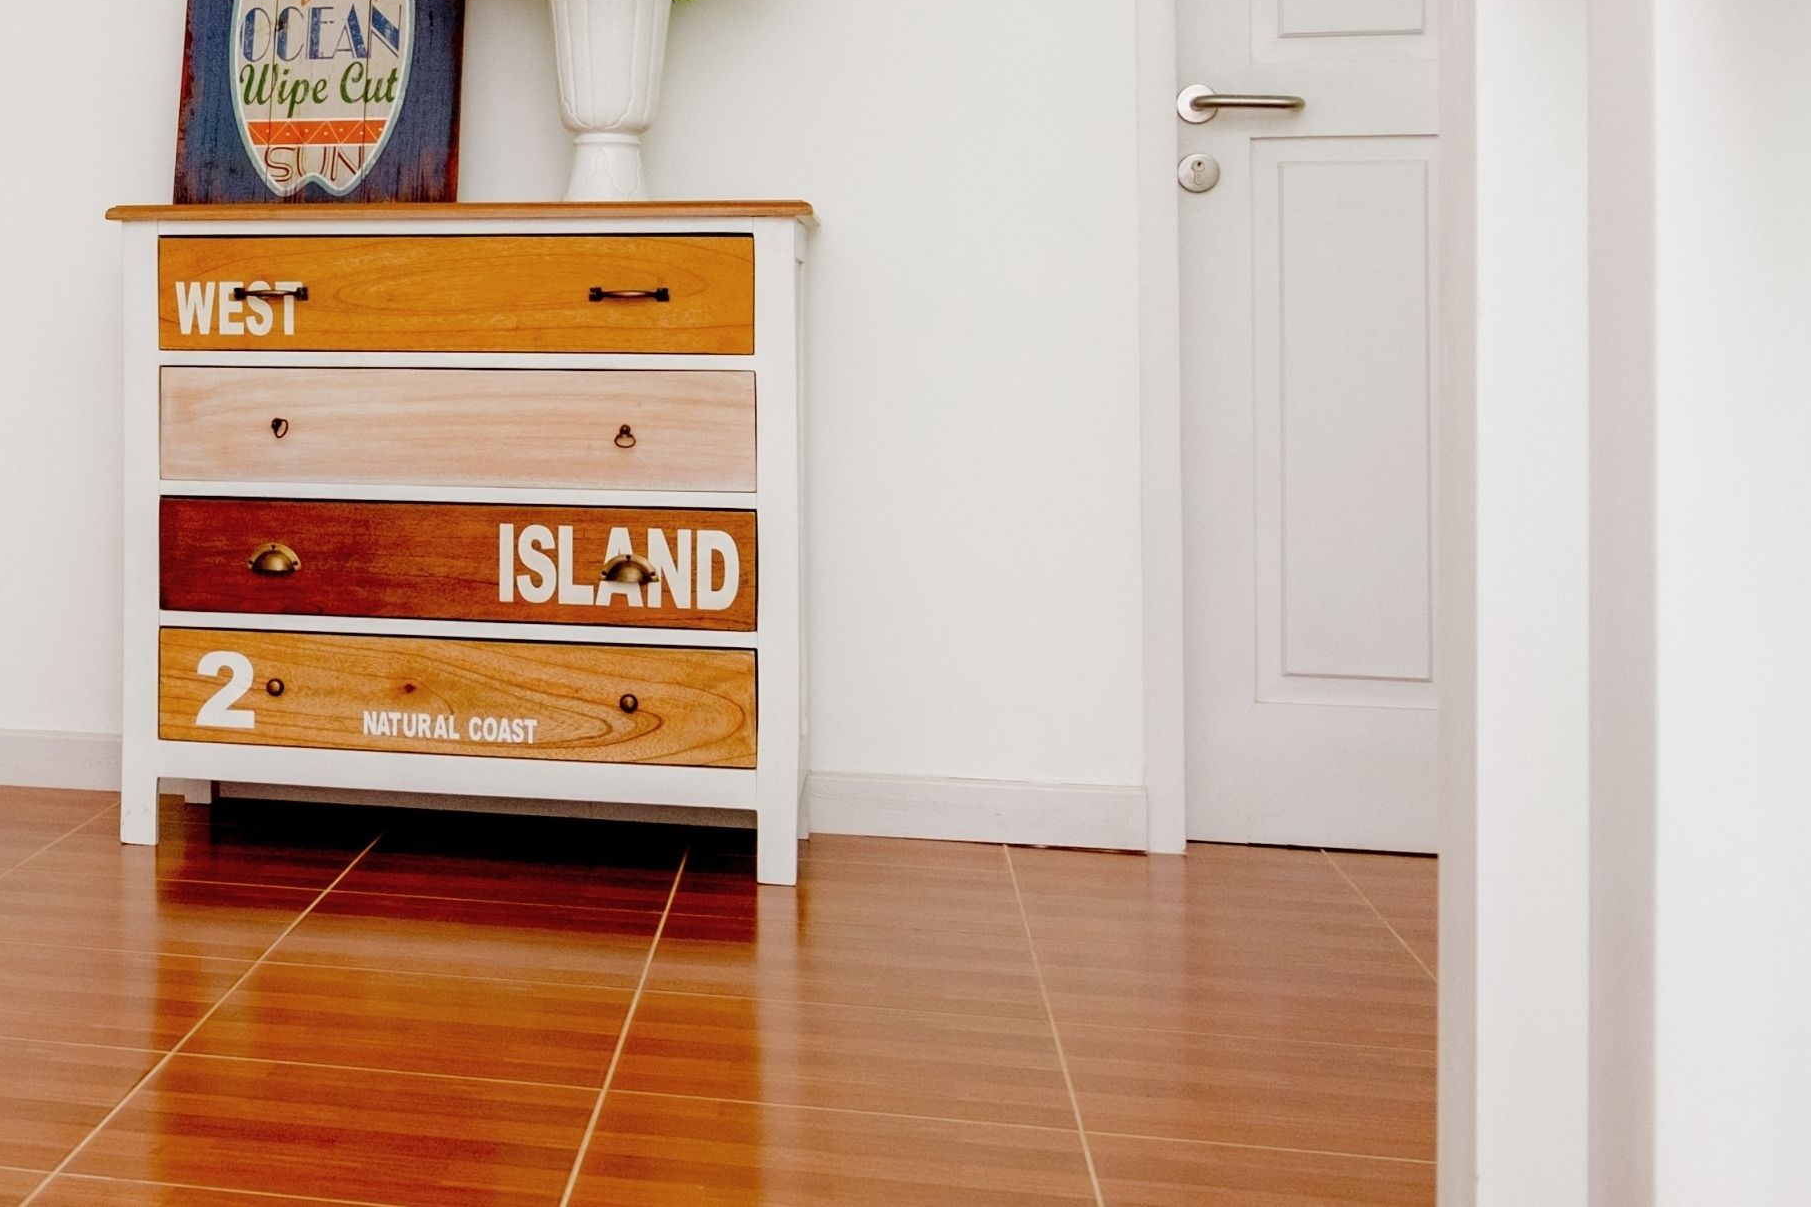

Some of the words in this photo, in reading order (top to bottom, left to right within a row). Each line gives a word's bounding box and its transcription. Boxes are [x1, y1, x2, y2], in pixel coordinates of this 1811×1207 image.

[240, 3, 402, 62] OCEAN
[239, 63, 329, 119] Wipe
[264, 146, 364, 182] SUN
[175, 280, 304, 336] WEST
[499, 523, 740, 611] ISLAND
[195, 650, 255, 729] 2
[362, 710, 460, 740] NATURAL
[468, 716, 538, 744] COAST
